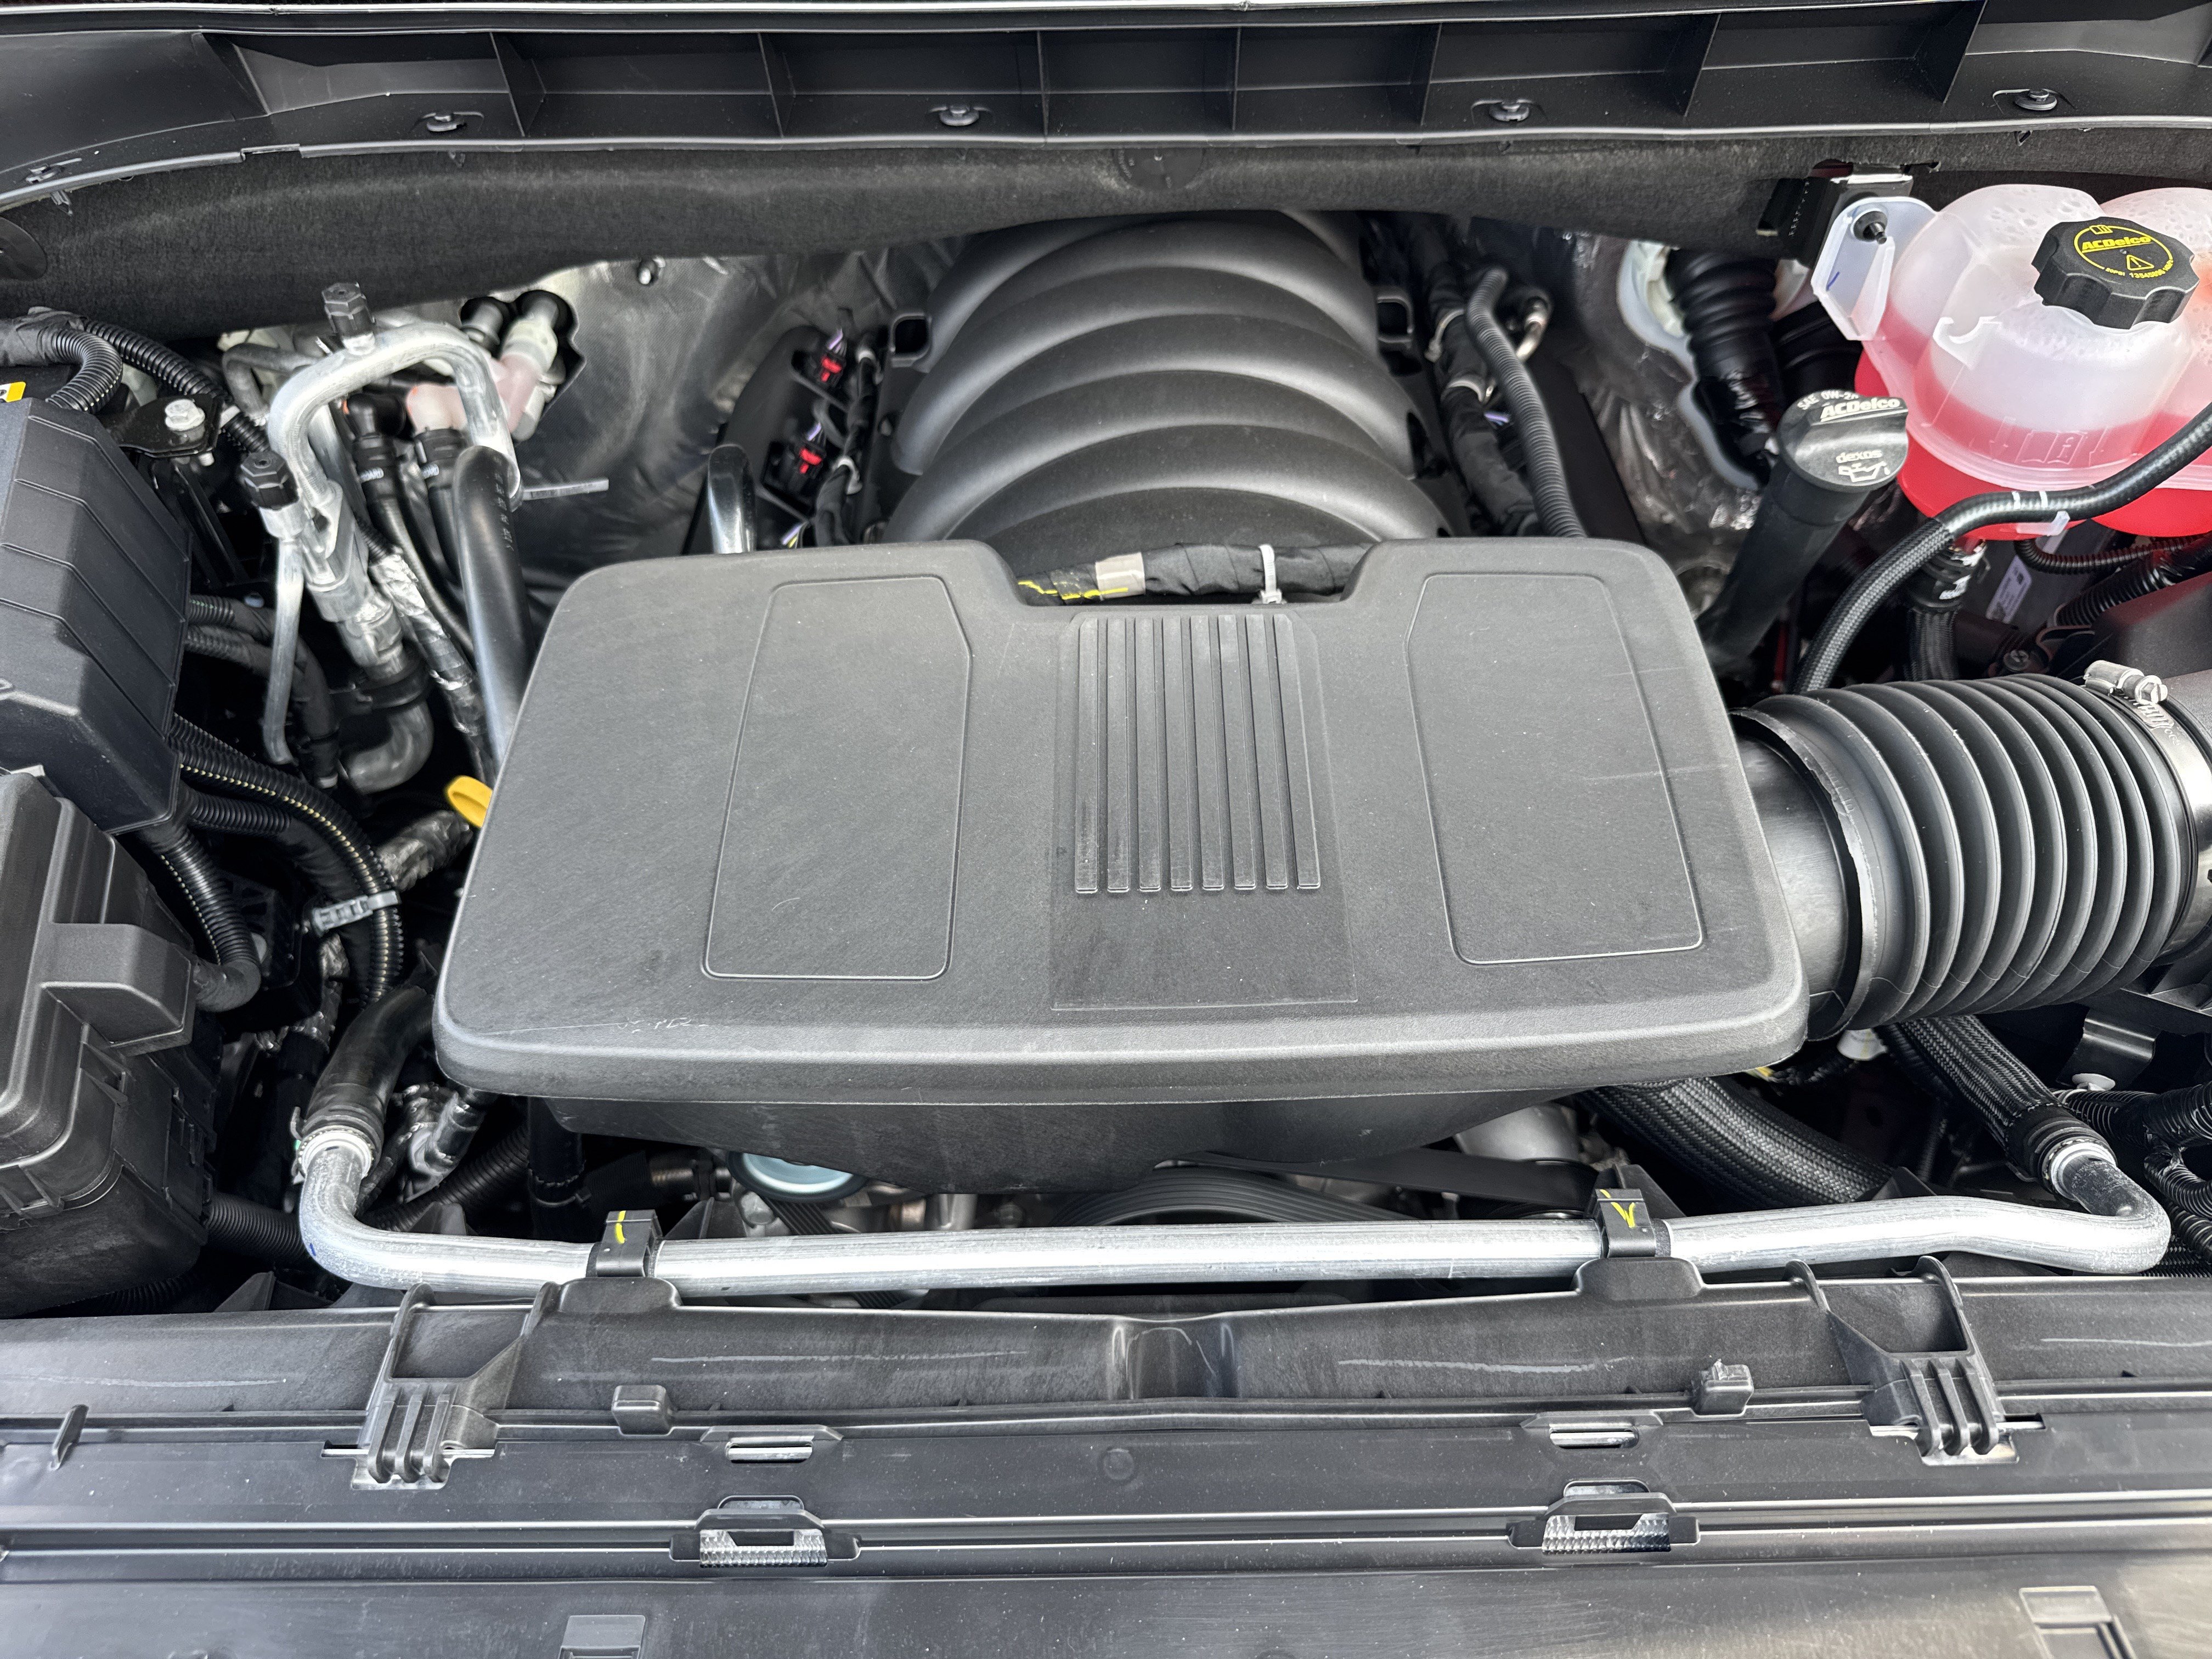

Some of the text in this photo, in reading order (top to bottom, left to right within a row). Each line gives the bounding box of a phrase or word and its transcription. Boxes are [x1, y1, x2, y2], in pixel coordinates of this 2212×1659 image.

[2082, 236, 2152, 251] ACDelco
[1797, 393, 1820, 410] SAE
[1820, 398, 1901, 419] ACDelco
[1836, 449, 1883, 464] dexos
